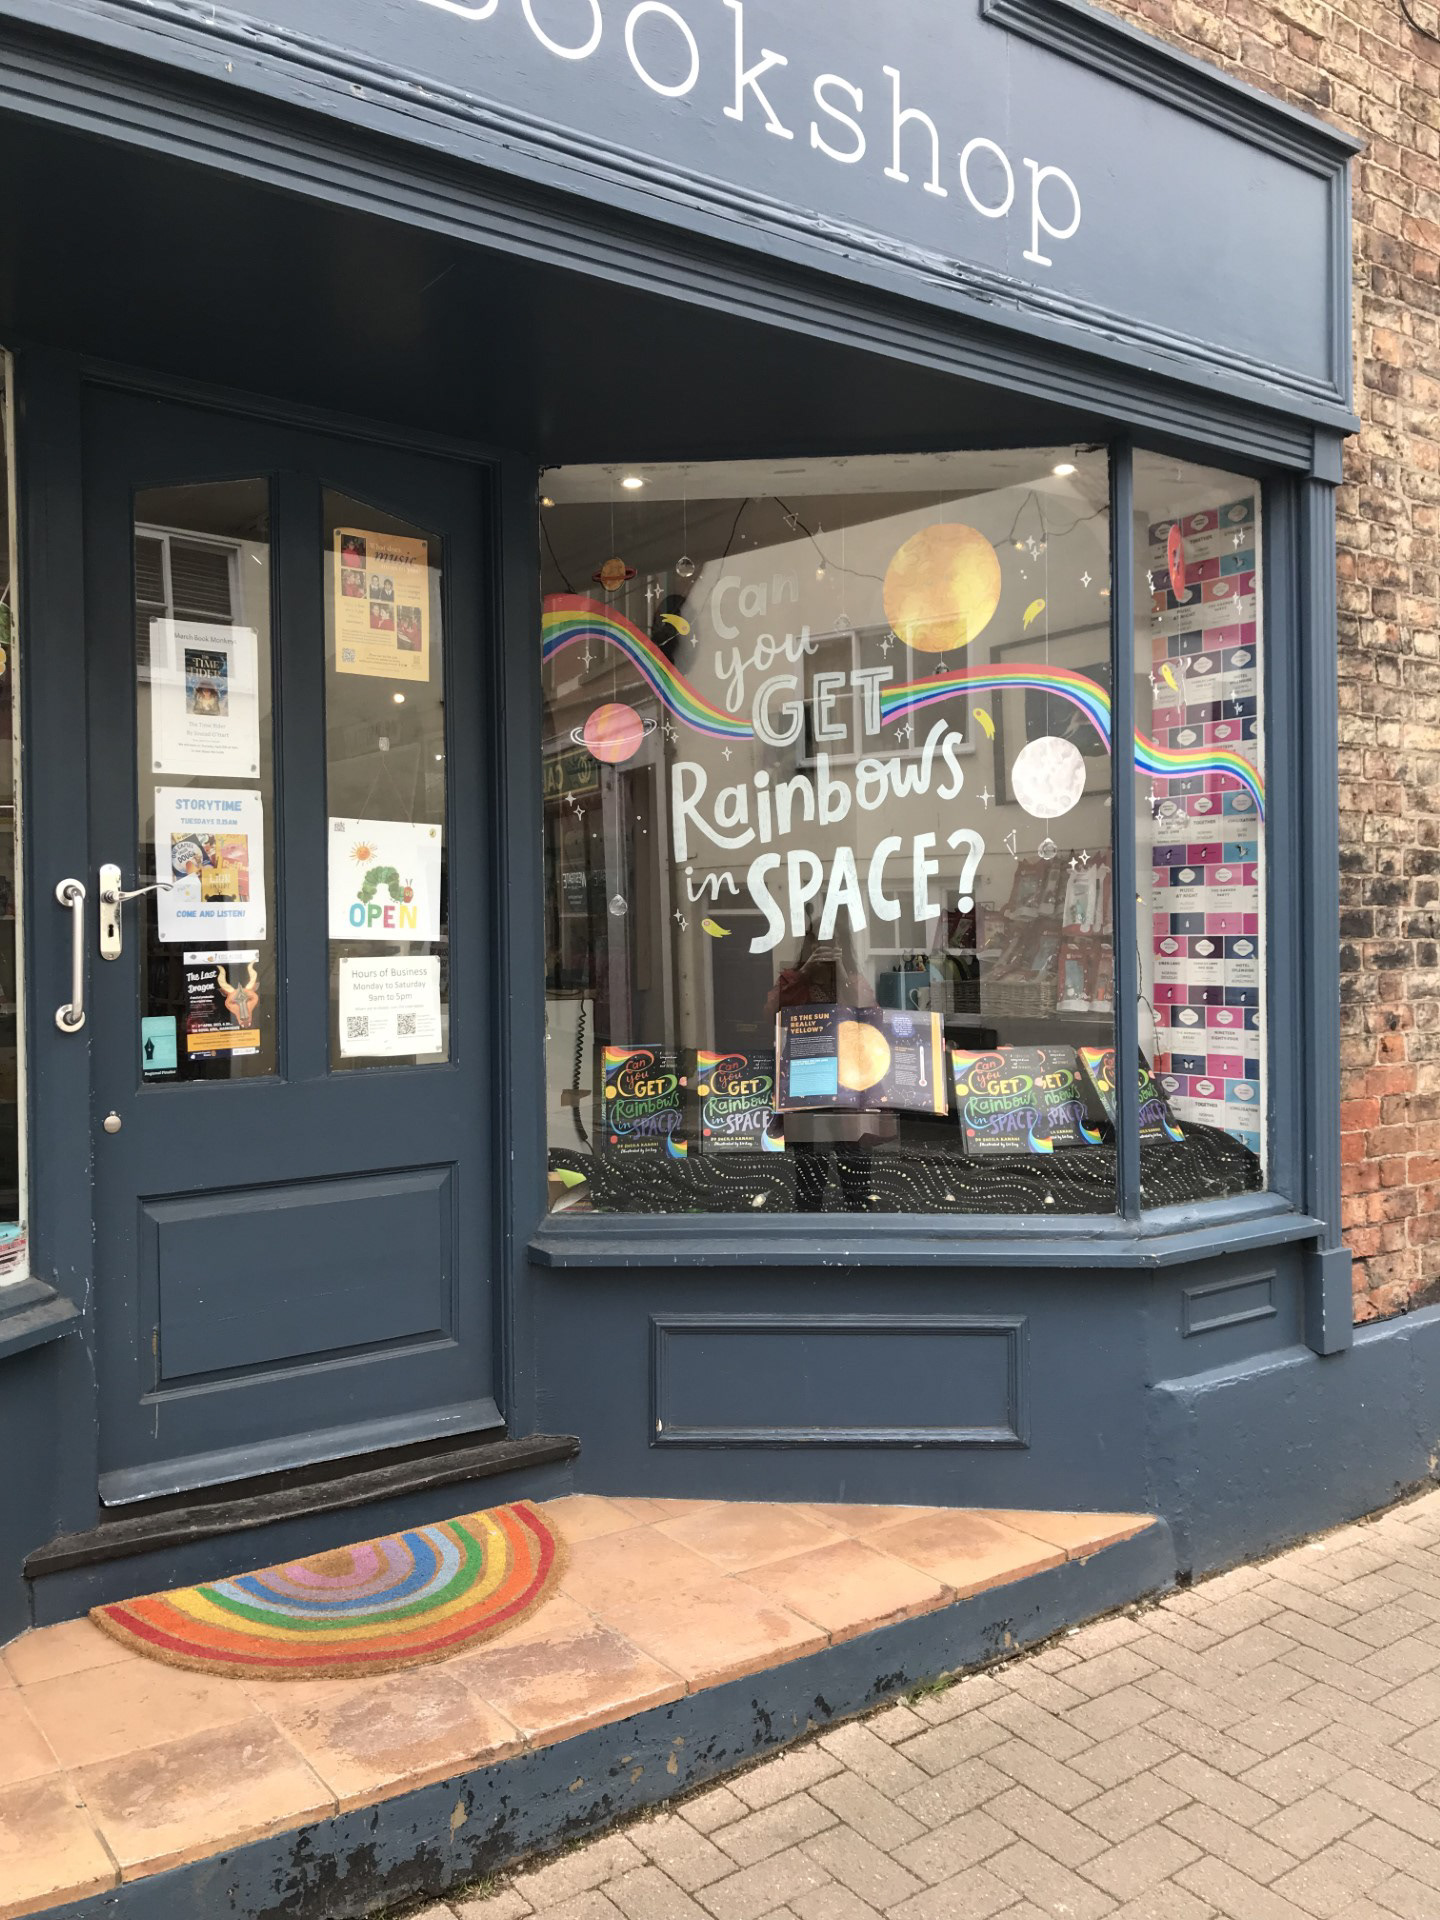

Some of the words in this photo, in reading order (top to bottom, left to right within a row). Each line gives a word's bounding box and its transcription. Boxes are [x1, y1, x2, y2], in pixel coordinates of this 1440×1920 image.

[417, 0, 1082, 267] ookshop
[375, 551, 417, 564] music
[711, 568, 799, 639] Can
[174, 632, 193, 640] March
[194, 634, 210, 642] Book
[192, 658, 220, 668] TIME
[715, 625, 819, 713] you
[752, 665, 894, 747] GET
[671, 718, 964, 863] Rainbows
[175, 798, 242, 811] STORYTIME
[180, 817, 215, 825] TUESDAYS
[684, 865, 740, 902] in
[745, 828, 986, 954] SPACE?
[217, 910, 246, 918] LISTEN!
[349, 903, 417, 928] OPEN
[186, 972, 200, 982] The
[200, 970, 217, 980] Last
[351, 969, 377, 979] Hours
[379, 968, 388, 977] of
[391, 967, 428, 977] Business
[187, 983, 215, 993] Dragon
[353, 983, 383, 991] Monday
[394, 980, 426, 990] Saturday
[368, 994, 385, 1002] 9am
[396, 993, 413, 1002] 5pm
[790, 1026, 824, 1034] YELLOW?
[626, 1060, 646, 1074] Can
[719, 1062, 739, 1074] Can
[975, 1060, 996, 1073] Can
[626, 1071, 649, 1089] you
[719, 1072, 743, 1089] you
[728, 1079, 760, 1096] GET
[976, 1071, 1001, 1088] you
[987, 1079, 1019, 1095] GET
[634, 1079, 666, 1097] GET
[1044, 1083, 1081, 1105] nbows
[616, 1090, 680, 1121] Rainbows
[969, 1090, 1038, 1116] Rainbows
[618, 1121, 631, 1129] in
[633, 1113, 683, 1140] SPACE?
[711, 1116, 725, 1125] in
[974, 1116, 987, 1124] in
[989, 1110, 1043, 1135] SPACE?
